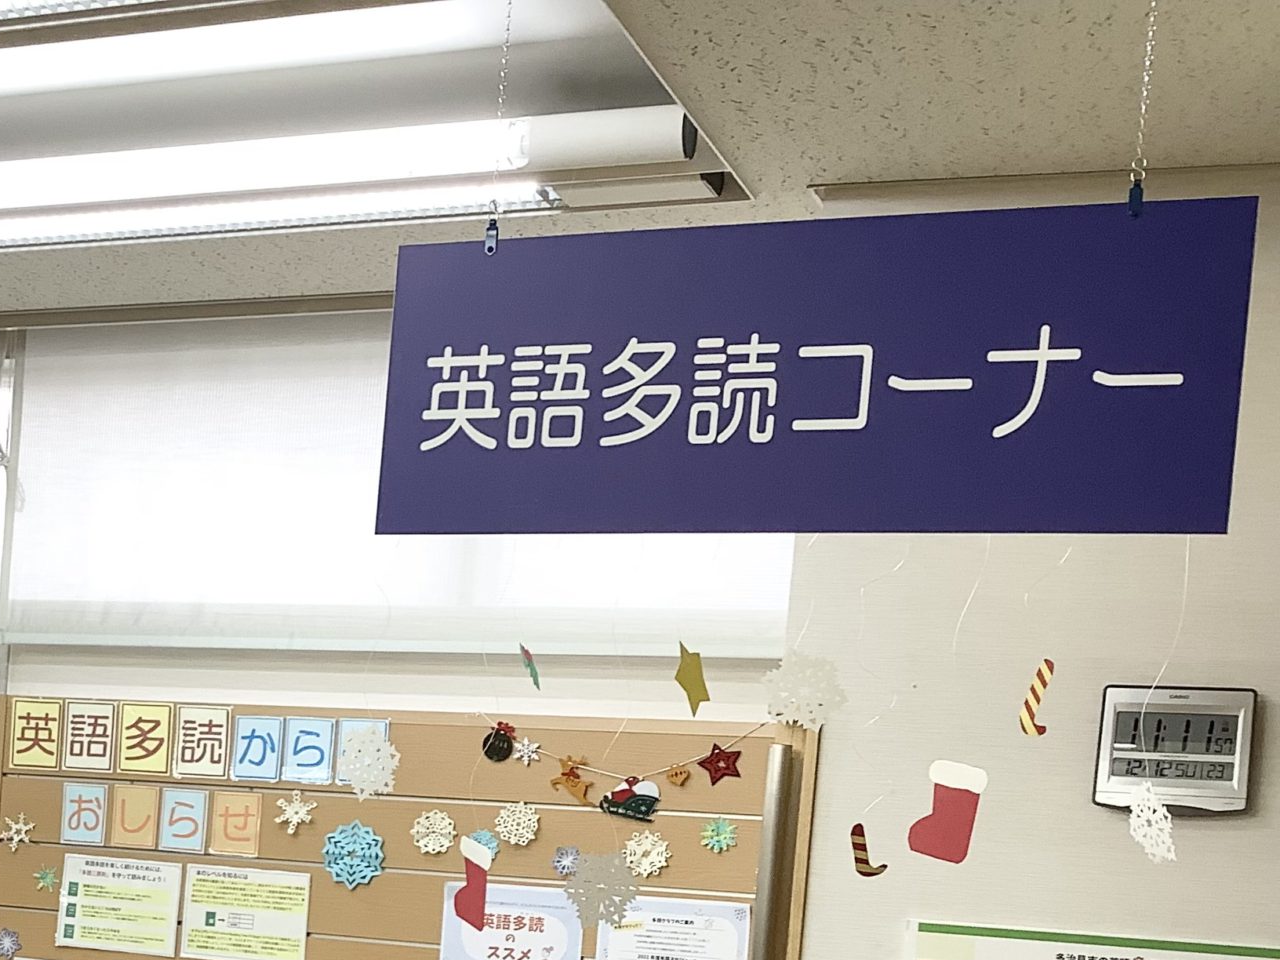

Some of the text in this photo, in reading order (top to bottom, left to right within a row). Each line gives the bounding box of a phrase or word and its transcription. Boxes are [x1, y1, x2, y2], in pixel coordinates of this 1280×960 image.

[420, 323, 1185, 452] 英語多読コーナー
[16, 712, 327, 769] 英語多読から
[67, 794, 256, 843] おしらせ
[483, 912, 546, 933] 英語多読
[506, 934, 516, 943] の
